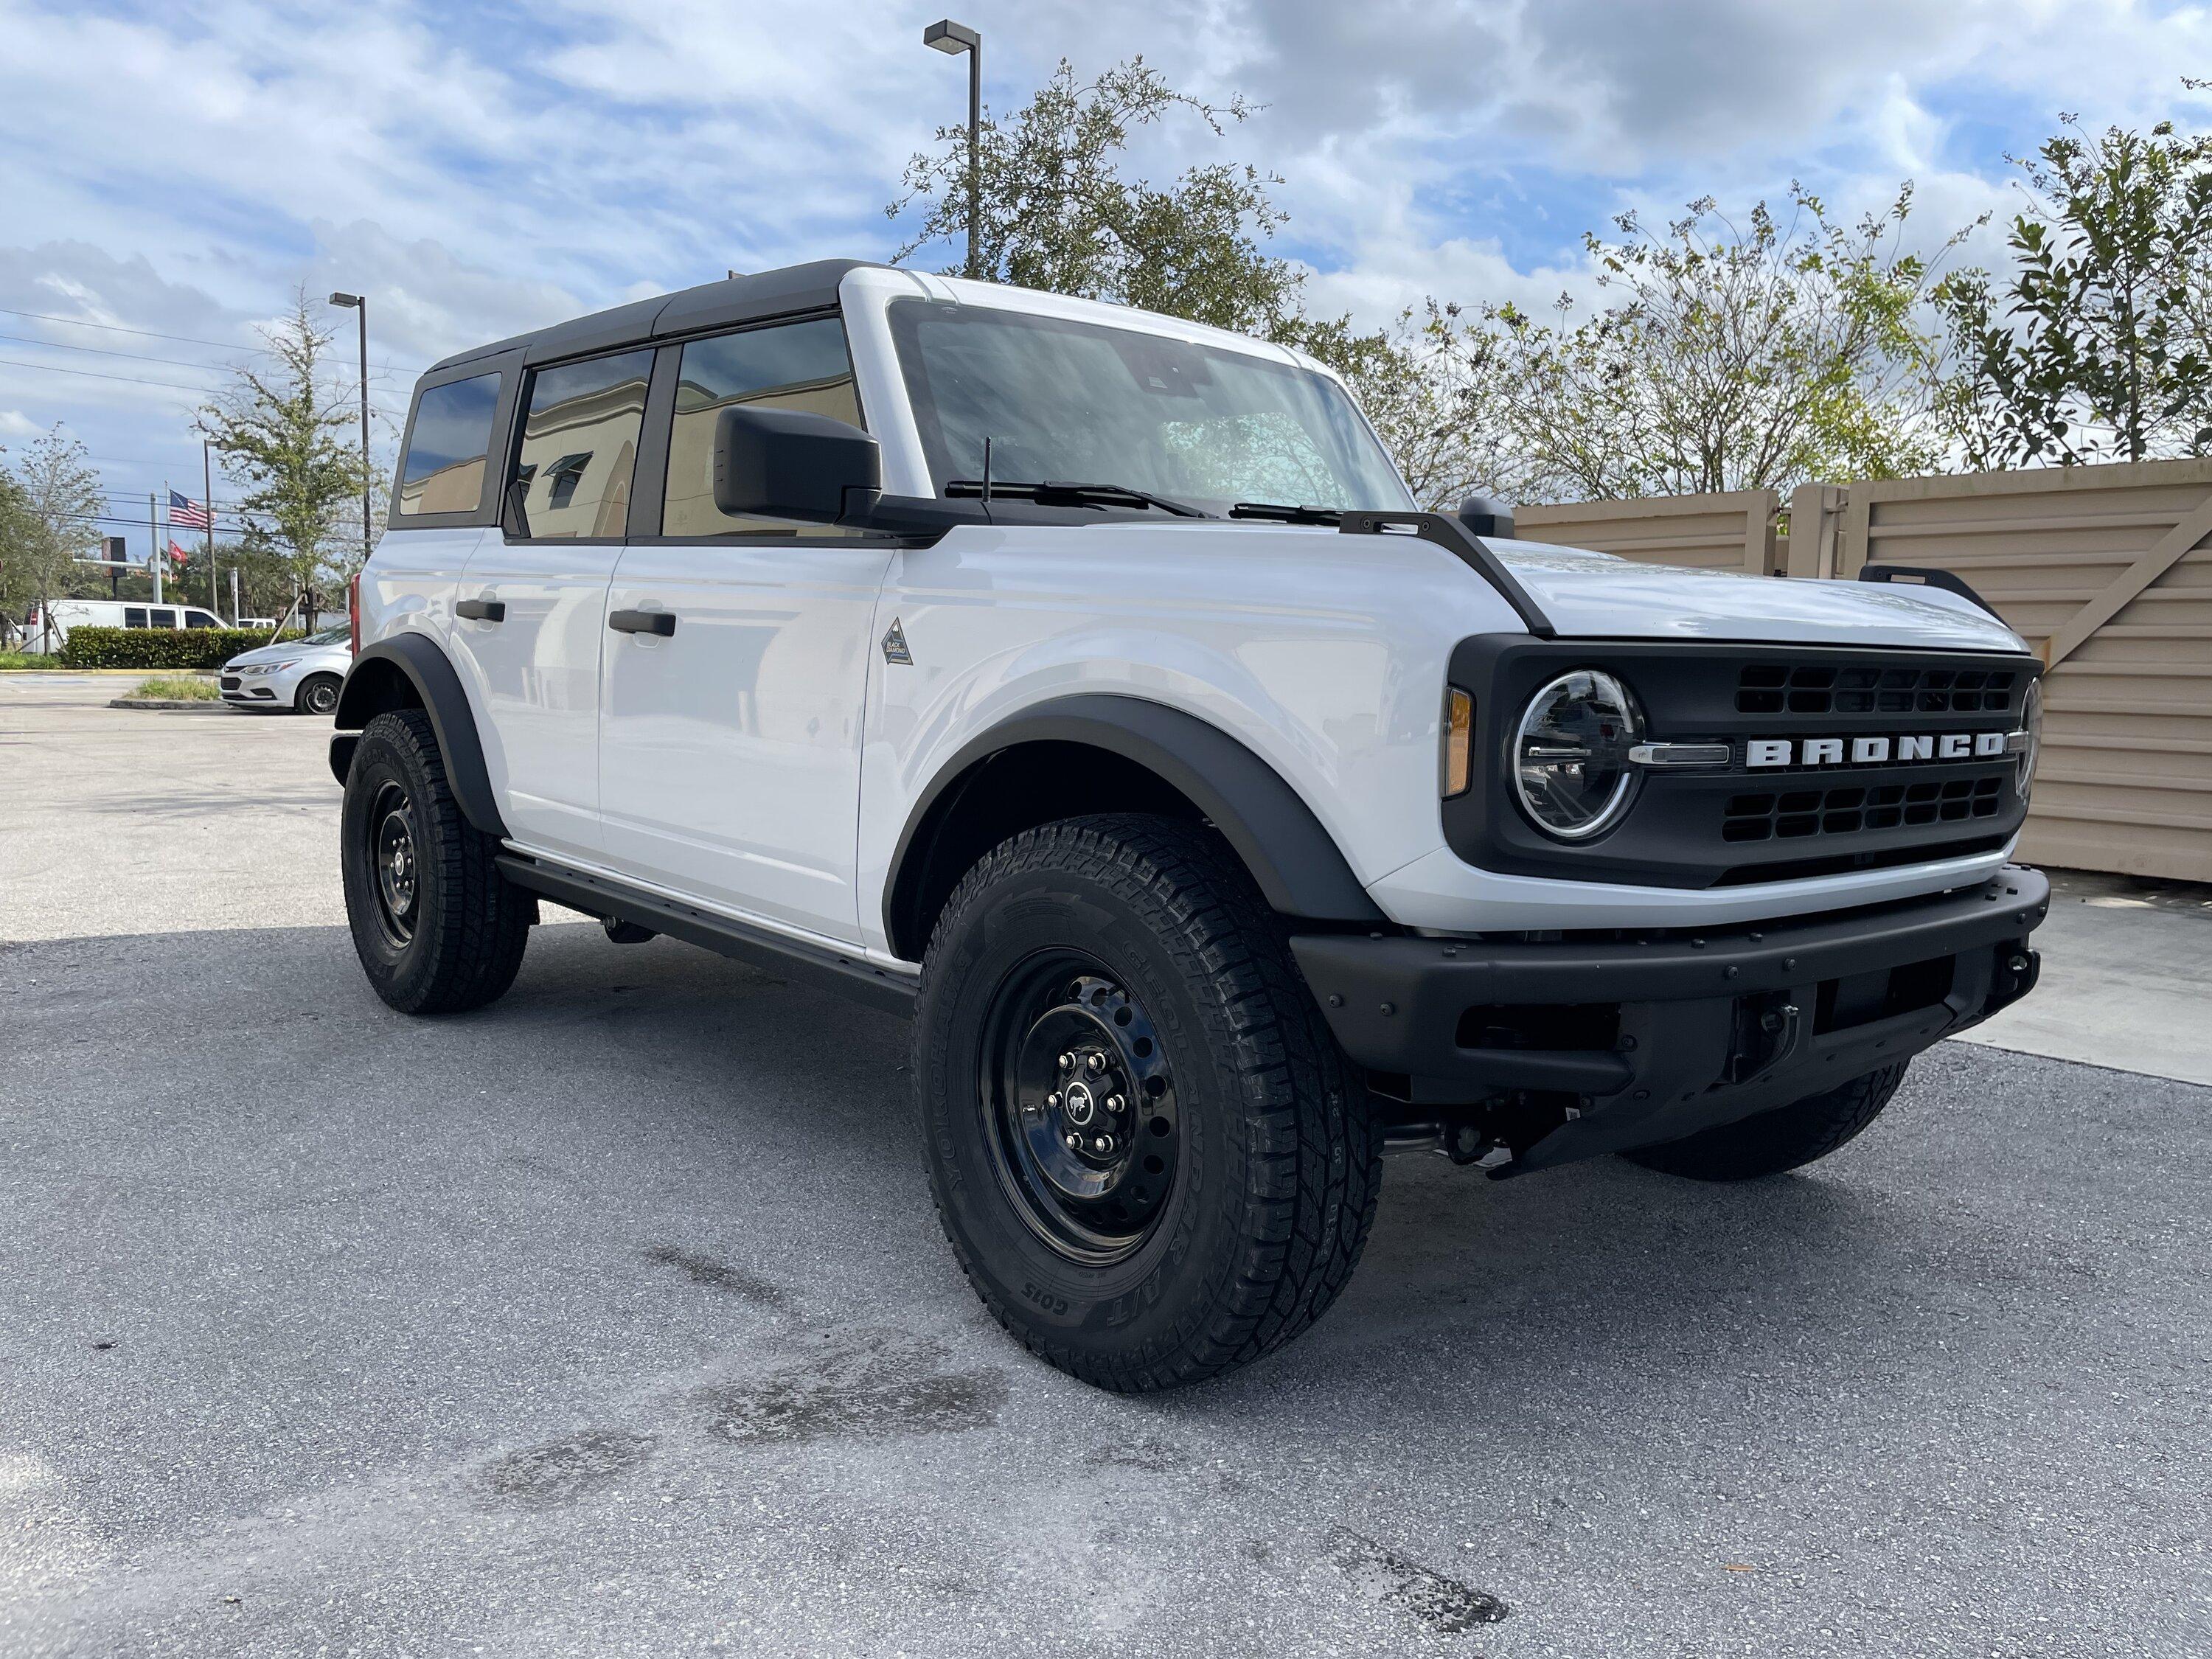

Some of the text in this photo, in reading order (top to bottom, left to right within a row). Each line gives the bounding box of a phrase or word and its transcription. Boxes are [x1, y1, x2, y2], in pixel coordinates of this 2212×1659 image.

[1747, 733, 2004, 767] BRONCO
[930, 946, 974, 1190] YOKOHAMA
[1121, 939, 1205, 1266] GEOLANDAR
